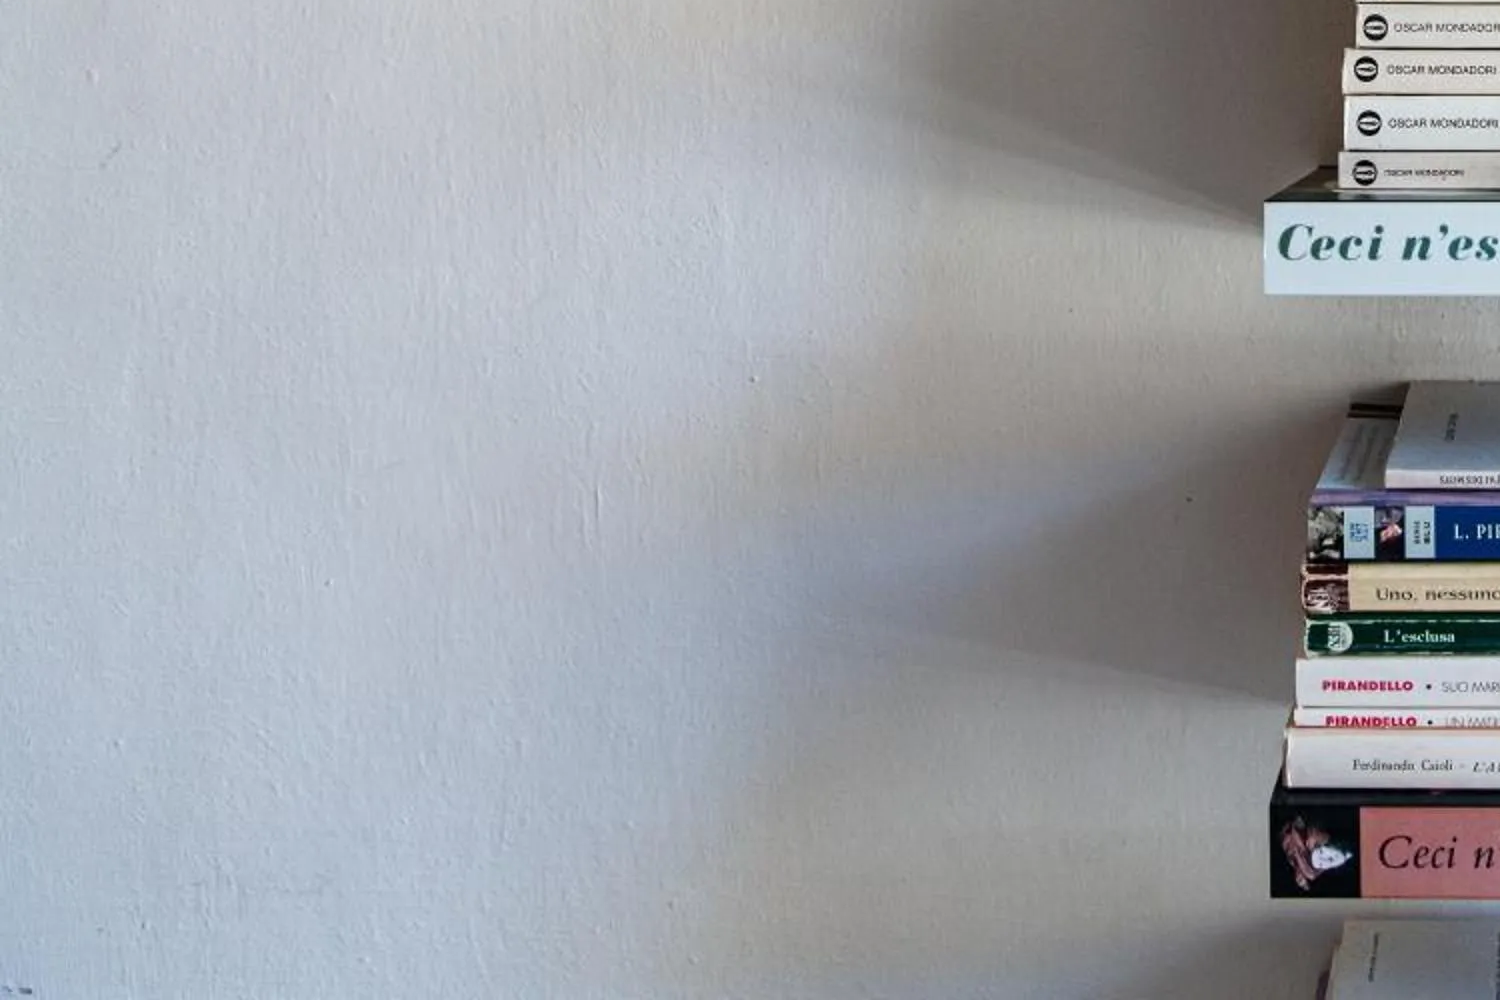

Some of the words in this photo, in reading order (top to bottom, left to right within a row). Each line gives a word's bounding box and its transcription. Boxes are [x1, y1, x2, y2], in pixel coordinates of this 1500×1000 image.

[1394, 23, 1433, 33] OSCAR
[1387, 65, 1425, 75] OSCAR
[1428, 65, 1497, 75] MONDADORI
[1388, 118, 1427, 128] OSCAR
[1430, 118, 1499, 128] MONDADORI
[1277, 223, 1385, 261] Ceci
[1454, 523, 1469, 539] L.
[1376, 588, 1418, 602] Uno,
[1384, 630, 1455, 643] L'esclusa
[1322, 681, 1414, 692] PIRANDELLO
[1442, 682, 1468, 693] SUO
[1326, 716, 1417, 727] PIRANDELLO
[1378, 835, 1458, 870] Ceci
